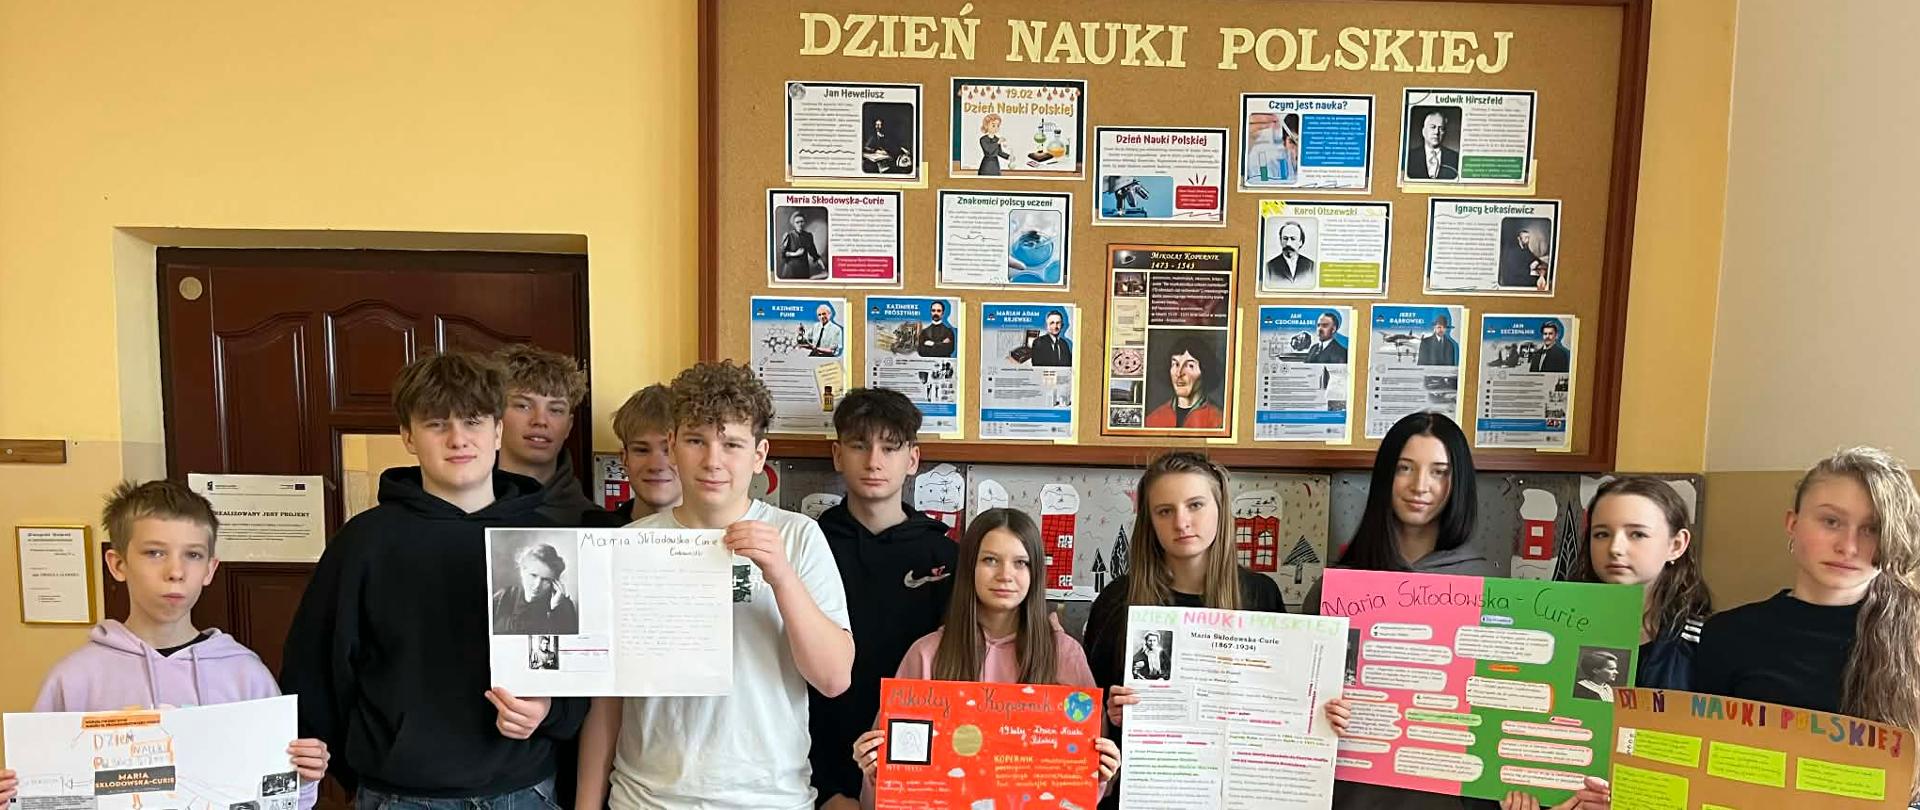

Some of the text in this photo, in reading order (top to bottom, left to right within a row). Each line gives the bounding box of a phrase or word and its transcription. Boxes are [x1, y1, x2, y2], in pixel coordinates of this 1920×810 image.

[800, 2, 1514, 75] DZIEŃ NAUKI POLSKIEJ
[823, 89, 885, 99] Jan Heweliusz
[1006, 88, 1033, 99] 19.02
[1269, 100, 1348, 111] Czym jest nauka?
[1435, 95, 1503, 105] Ludwik Hirszfeld
[963, 102, 1074, 117] Dzień Nauki Polskiej
[1116, 134, 1208, 147] Dzień Nauki Polskiej
[786, 195, 884, 205] Maria Skłodowska-Curie
[957, 197, 1053, 208] Znakomici polscy uczeni
[1294, 207, 1358, 216] Karol Olszewski
[1455, 204, 1535, 215] Ignacy Łukasiewicz
[581, 532, 630, 549] Maria
[1322, 593, 1386, 616] Maria
[1691, 694, 1767, 727] NAUKI
[118, 772, 149, 781] MARIA
